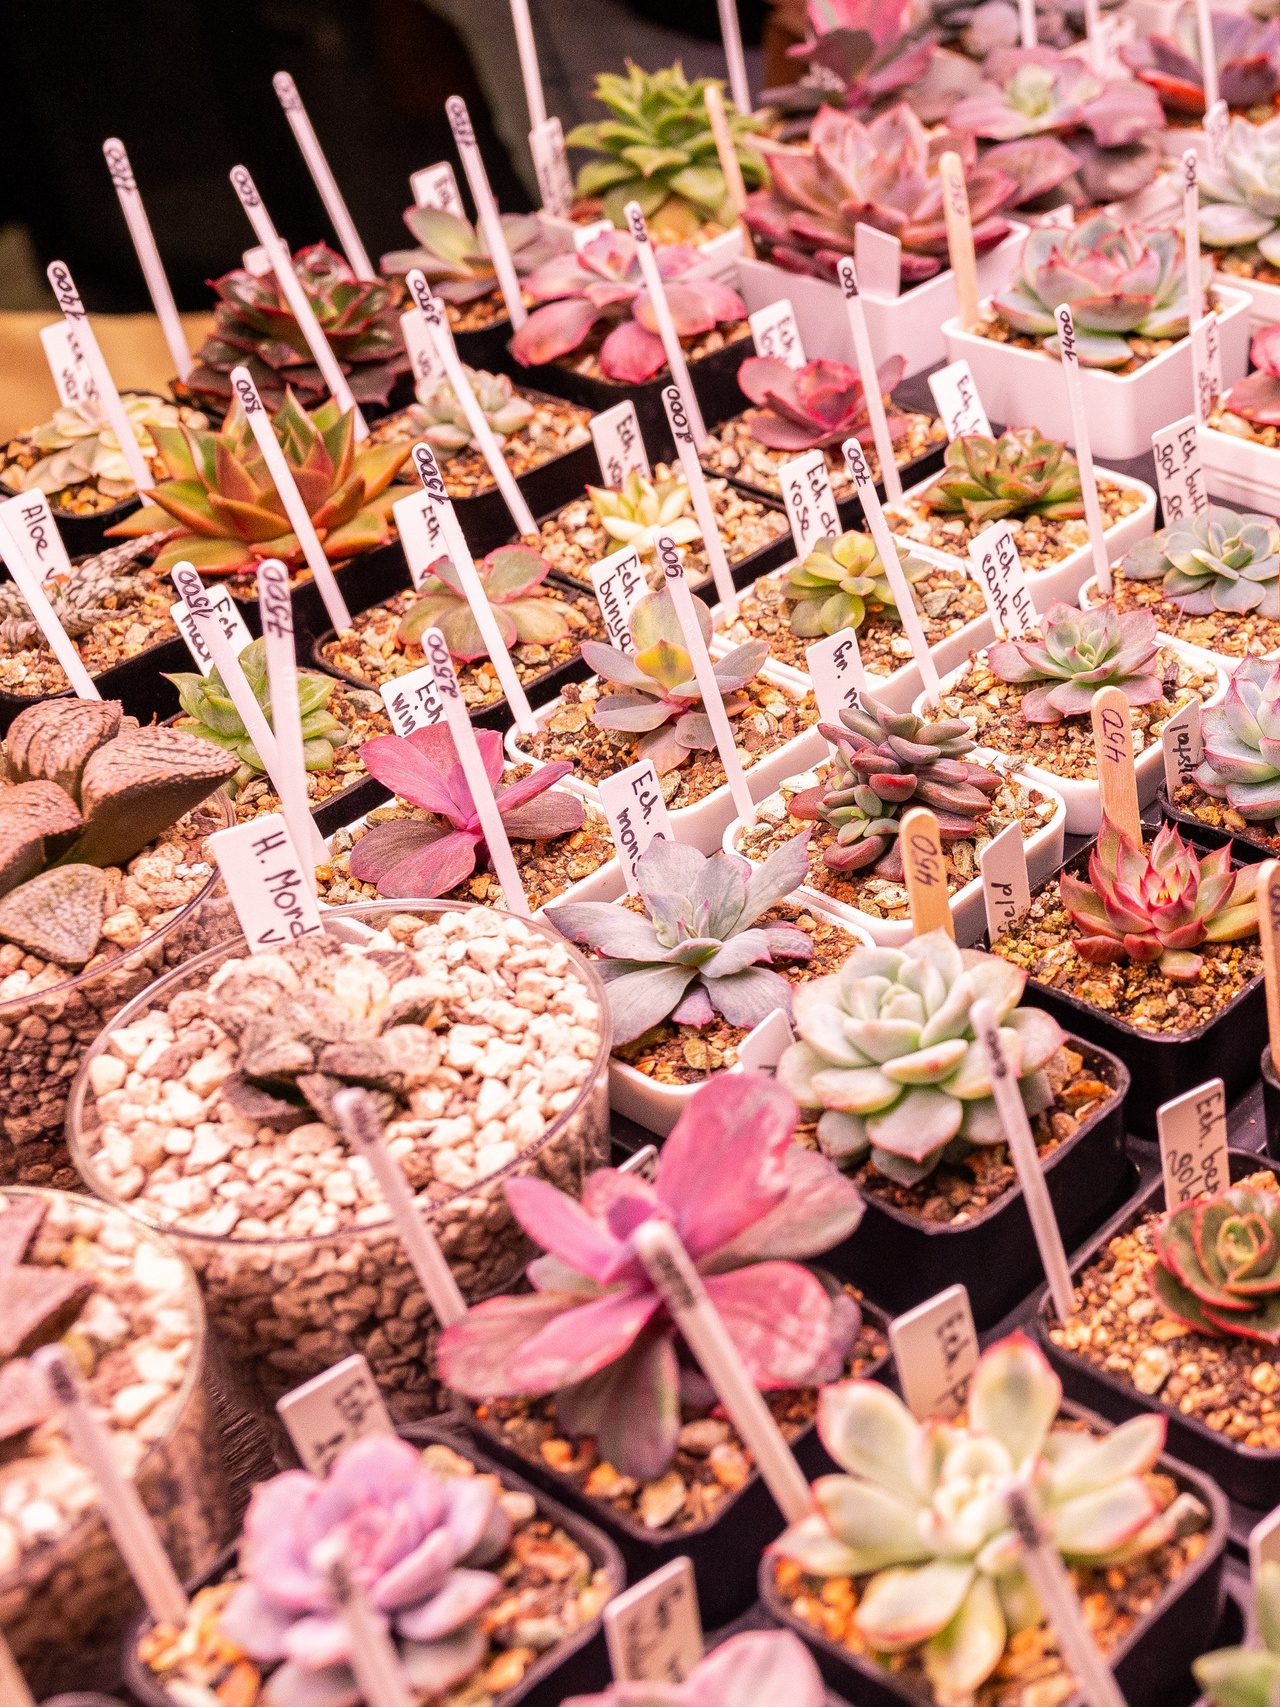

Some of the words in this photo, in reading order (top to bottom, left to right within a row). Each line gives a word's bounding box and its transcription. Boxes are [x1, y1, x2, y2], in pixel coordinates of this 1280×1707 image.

[52, 266, 85, 321] 1400
[1061, 310, 1077, 361] 1400
[847, 446, 873, 488] 700
[1178, 427, 1197, 464] Ech.
[416, 448, 450, 506] 1500
[806, 462, 827, 508] Ech.
[22, 504, 48, 562] Aloe
[658, 536, 684, 579] 900
[995, 532, 1012, 583] Ech.
[177, 570, 214, 619] 1500
[615, 554, 641, 606] Ech.
[427, 633, 460, 699] 2500
[1101, 709, 1126, 764] 450
[632, 771, 656, 822] Ech.
[251, 830, 287, 865] H.
[911, 834, 939, 886] 450
